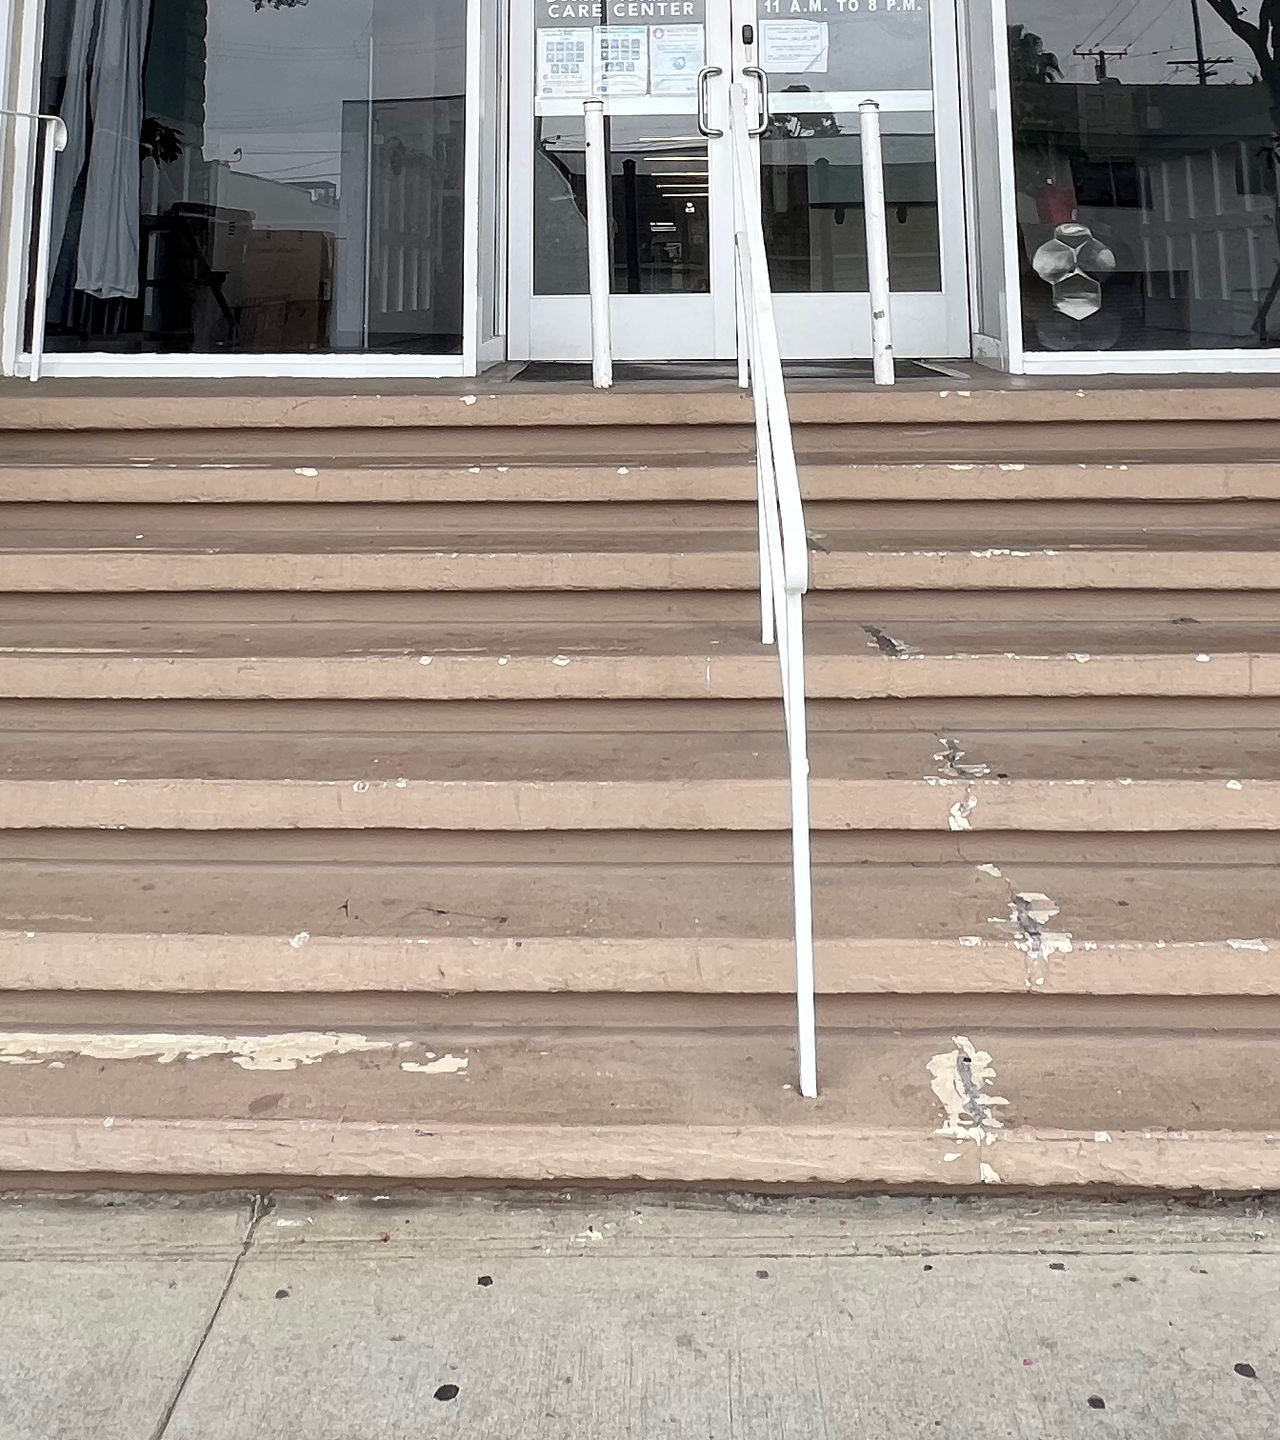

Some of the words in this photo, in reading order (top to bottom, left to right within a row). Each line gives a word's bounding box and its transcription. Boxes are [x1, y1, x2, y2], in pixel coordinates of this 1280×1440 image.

[547, 3, 602, 18] CARE
[613, 1, 694, 17] CENTER
[763, 0, 780, 13] 11
[790, 0, 828, 13] A.M.
